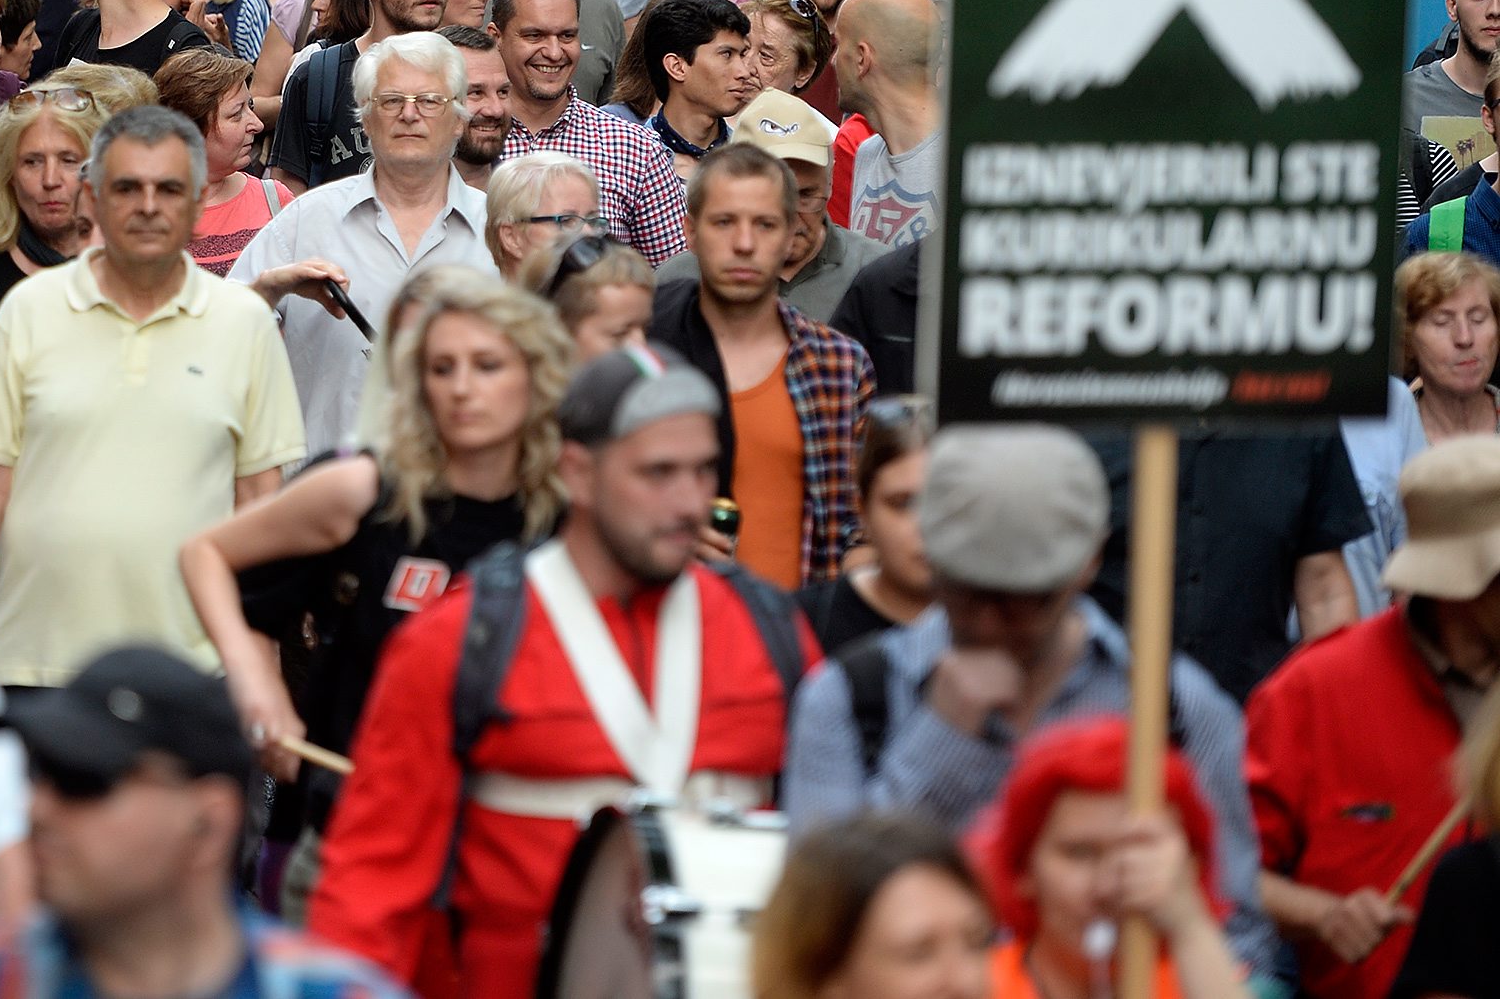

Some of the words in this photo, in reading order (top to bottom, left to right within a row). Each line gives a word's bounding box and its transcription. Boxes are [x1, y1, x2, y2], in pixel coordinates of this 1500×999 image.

[963, 143, 1280, 213] IZNEVJERILI
[1282, 141, 1381, 202] STE
[960, 208, 1379, 271] KURIKULARNU
[958, 273, 1378, 357] REFORMU!
